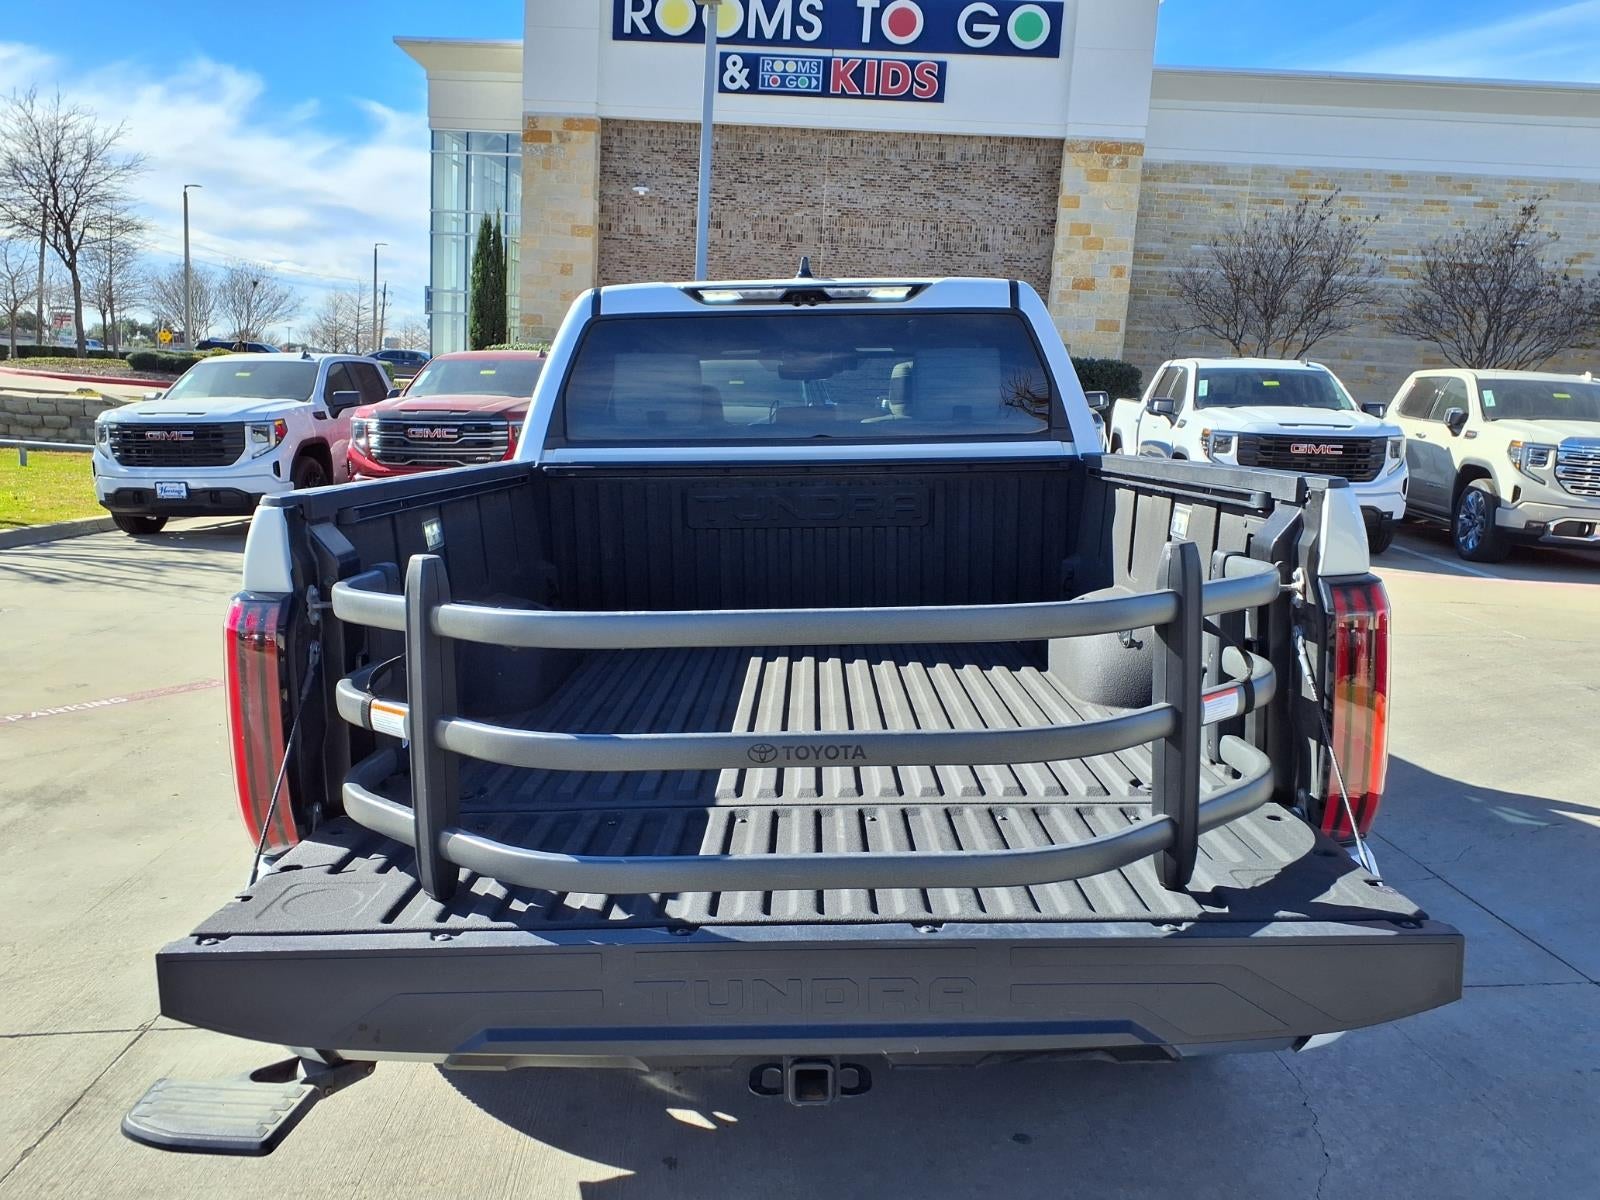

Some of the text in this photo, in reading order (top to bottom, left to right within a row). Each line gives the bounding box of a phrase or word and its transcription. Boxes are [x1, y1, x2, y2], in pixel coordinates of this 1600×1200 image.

[623, 0, 1050, 50] ROOMS TO GO
[722, 54, 750, 90] &
[763, 60, 818, 73] ROOMS
[763, 75, 809, 89] TO GO
[829, 57, 939, 99] KIDS
[145, 430, 194, 440] GMC
[408, 428, 458, 438] GMC
[1290, 443, 1344, 454] GMC
[695, 494, 922, 521] TUNDRA
[5, 696, 128, 722] PARKING
[782, 744, 867, 760] TOYOTA
[634, 976, 977, 1017] TUNDRA
